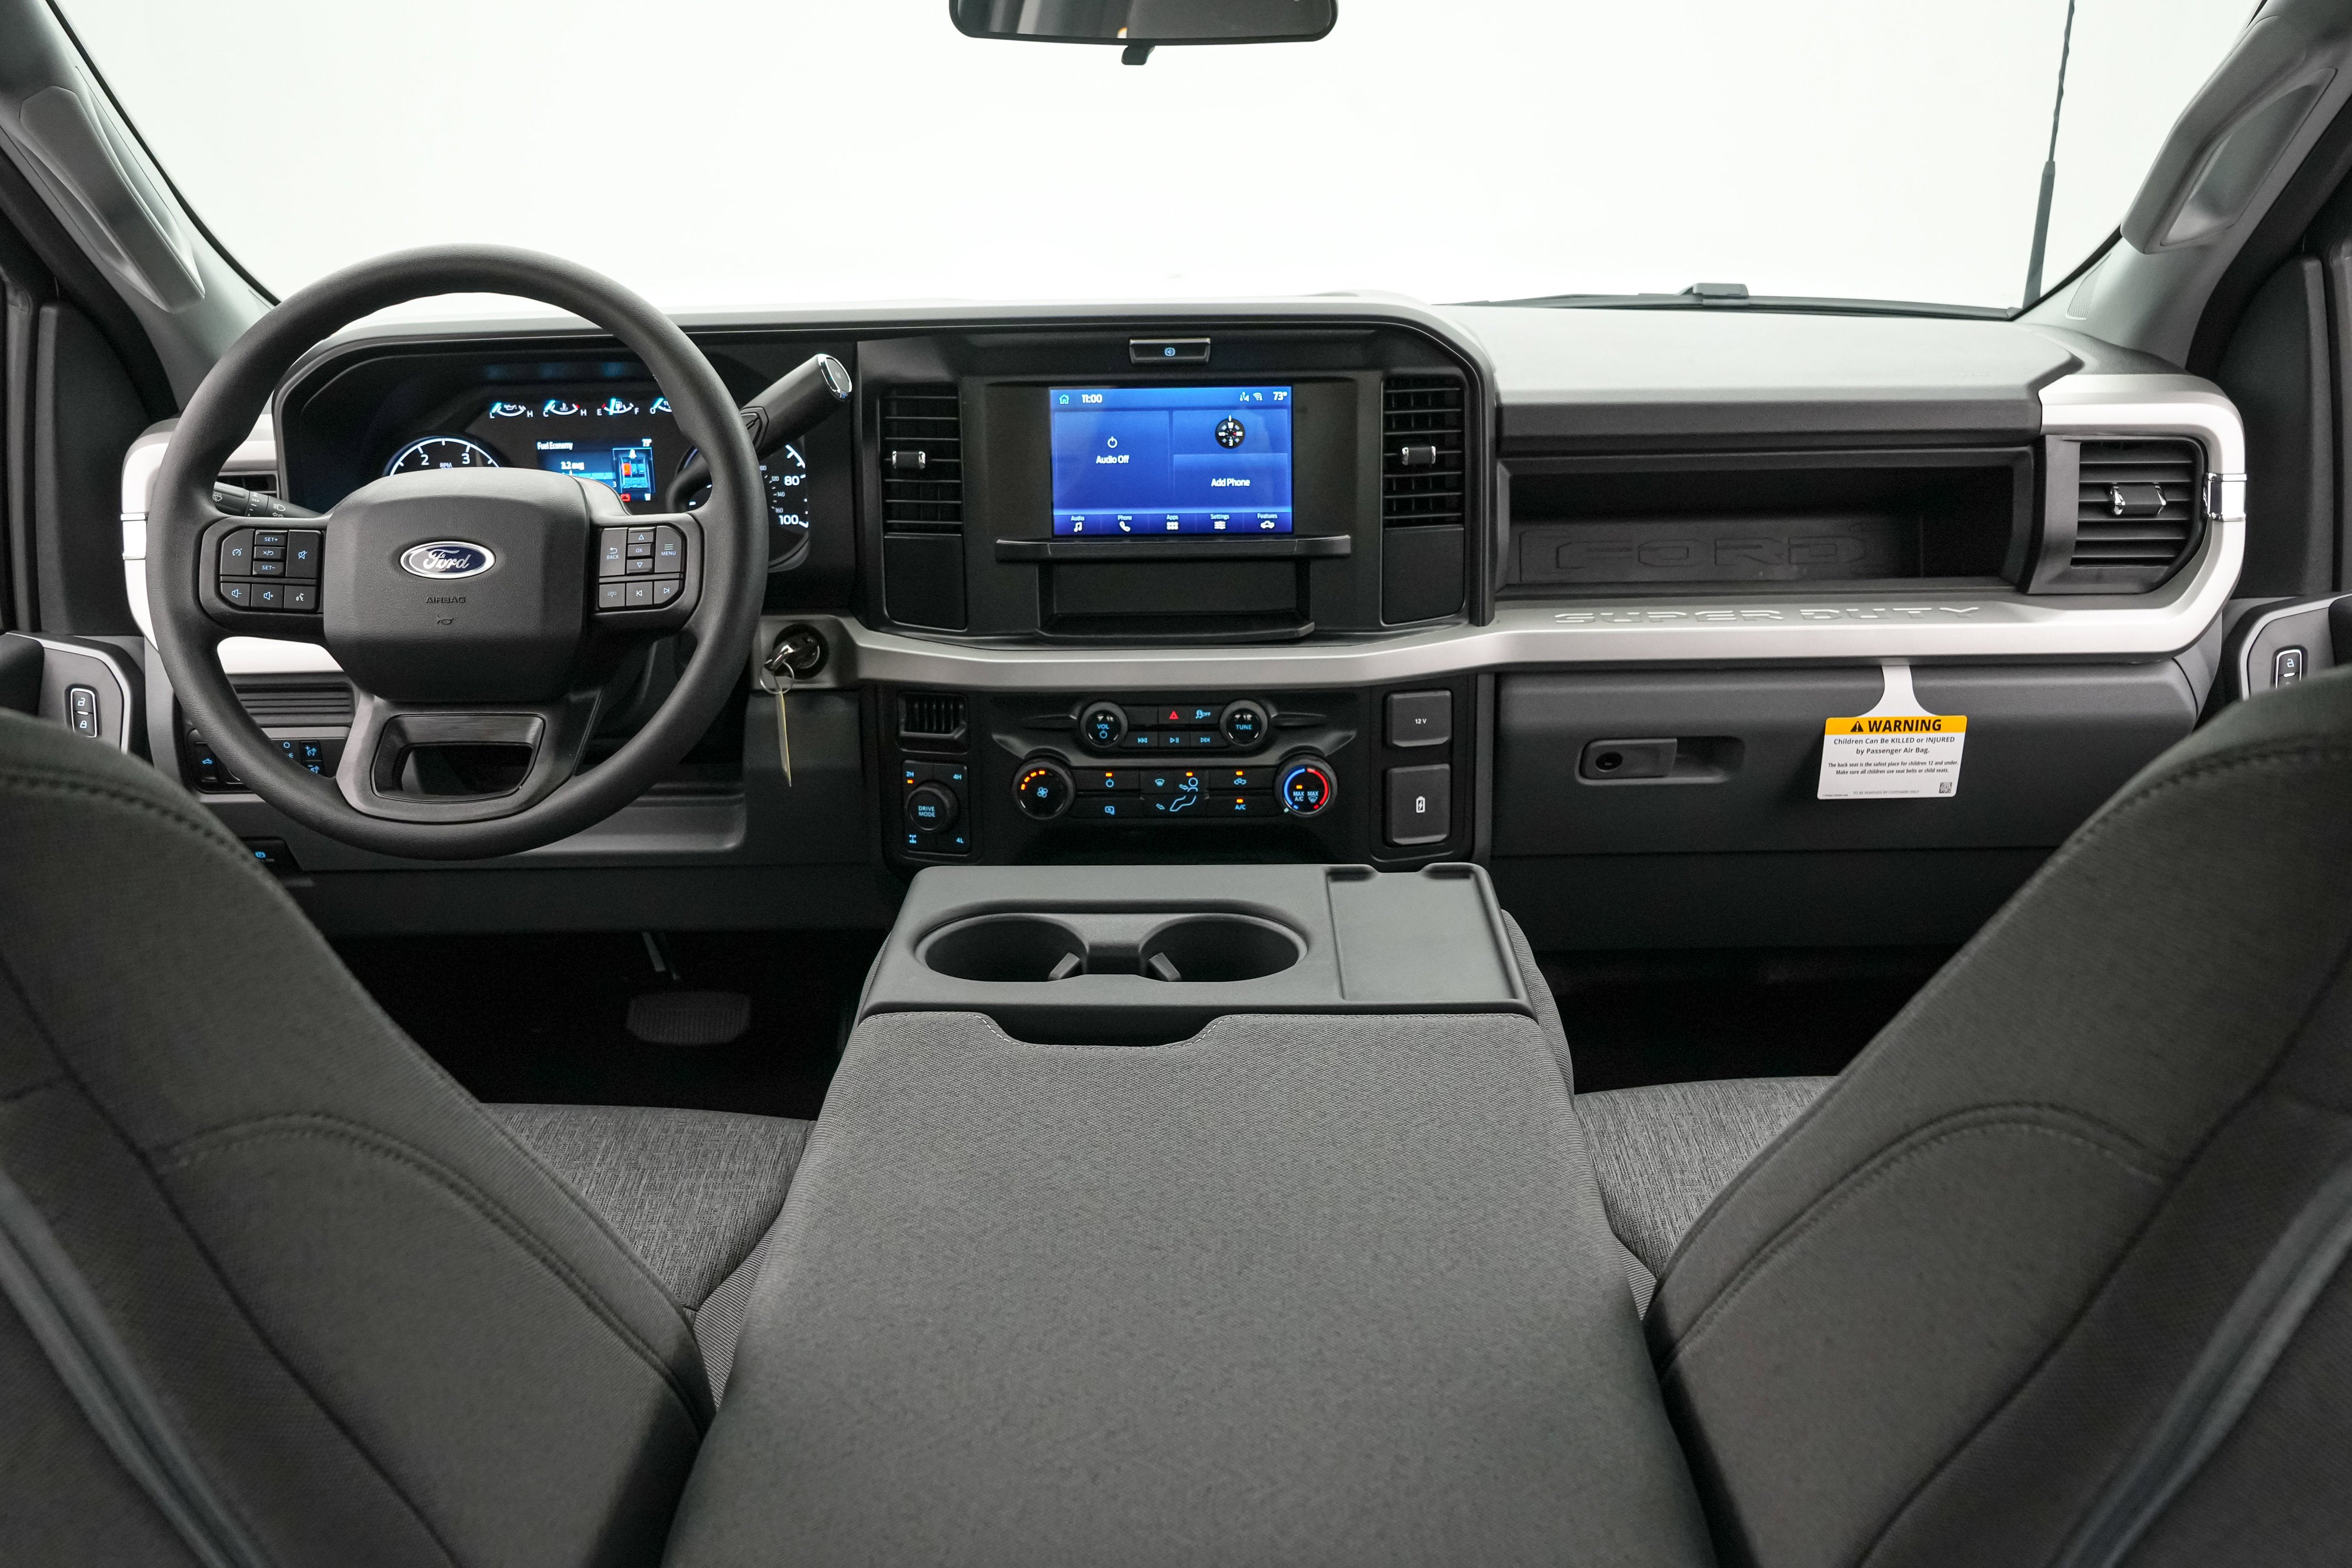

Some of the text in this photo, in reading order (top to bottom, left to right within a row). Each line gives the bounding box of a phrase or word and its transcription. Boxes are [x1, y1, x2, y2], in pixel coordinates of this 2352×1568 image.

[1081, 394, 1103, 403] 11:00
[537, 442, 573, 450] Fuel Economy
[420, 454, 429, 465] 2
[462, 453, 470, 464] 3
[1095, 454, 1130, 464] Audio Off
[784, 475, 800, 486] 80
[1211, 478, 1251, 487] Add Phone
[779, 514, 799, 525] 100
[1556, 534, 1866, 569] FORD
[423, 549, 472, 571] Ford
[1554, 606, 1979, 624] SUPER DUTY
[1868, 719, 1942, 733] WARNING
